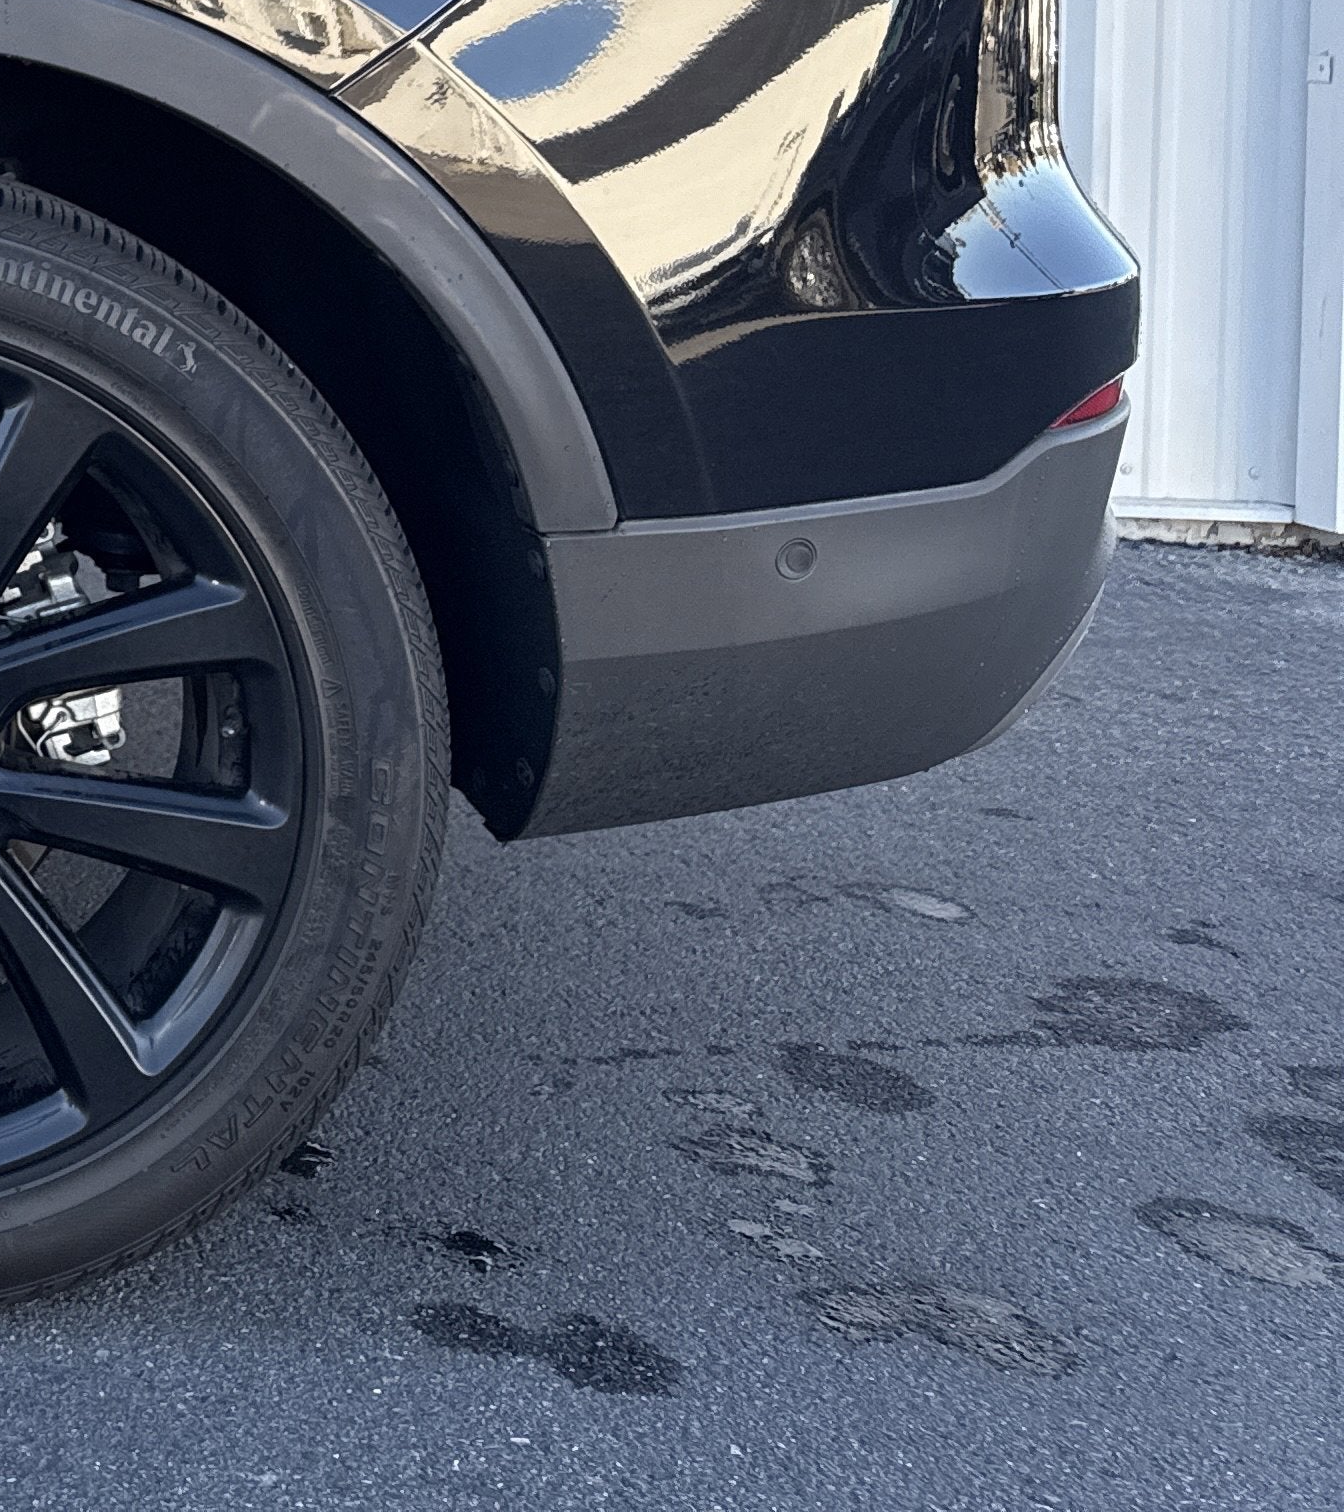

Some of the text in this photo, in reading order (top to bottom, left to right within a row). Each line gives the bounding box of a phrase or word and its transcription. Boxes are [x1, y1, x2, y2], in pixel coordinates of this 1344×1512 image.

[172, 757, 394, 1172] CONTINENTAL
[321, 937, 383, 1048] 245/50R20
[278, 1070, 316, 1110] 102V
